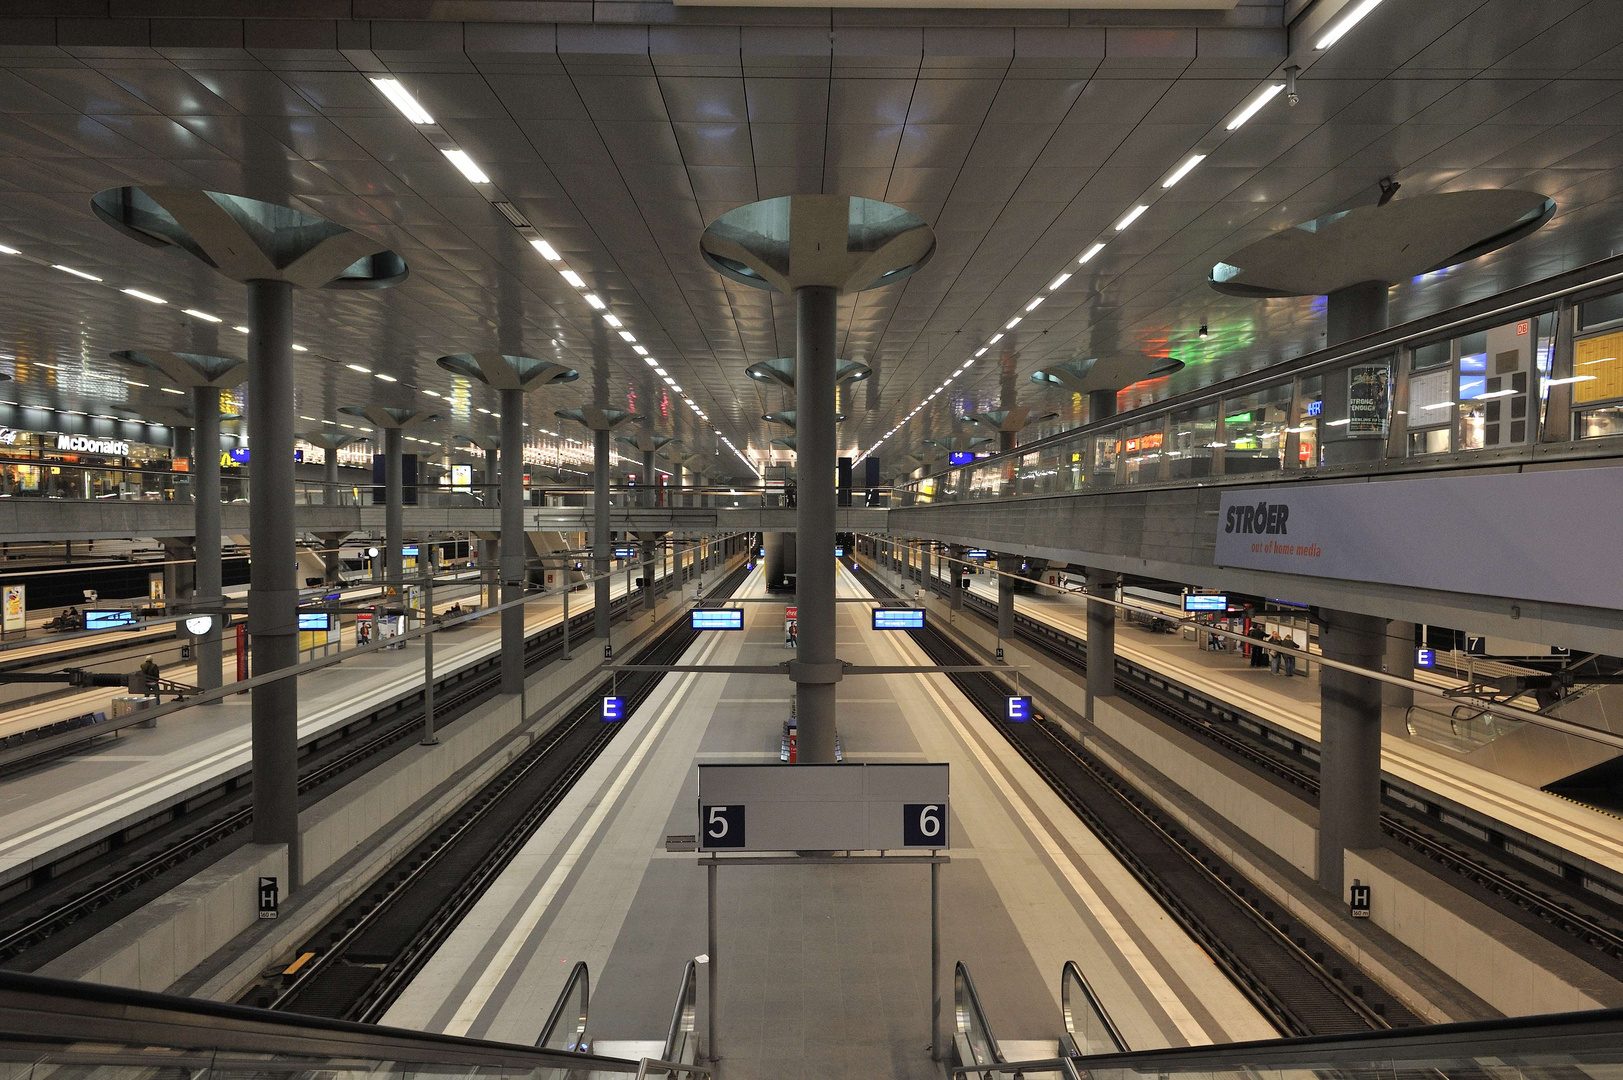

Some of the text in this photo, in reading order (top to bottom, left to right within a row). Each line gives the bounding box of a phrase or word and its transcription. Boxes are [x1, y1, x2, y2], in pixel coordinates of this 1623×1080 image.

[1517, 322, 1528, 335] DB
[57, 435, 129, 455] McDonald's
[1225, 502, 1289, 534] STRÖER
[1251, 541, 1322, 557] out of home media
[1470, 637, 1479, 650] 7
[1418, 649, 1429, 665] E
[603, 696, 617, 717] E
[1009, 697, 1022, 717] E
[708, 806, 729, 838] 5
[920, 805, 940, 837] 6
[262, 890, 275, 907] H
[1354, 890, 1367, 906] H
